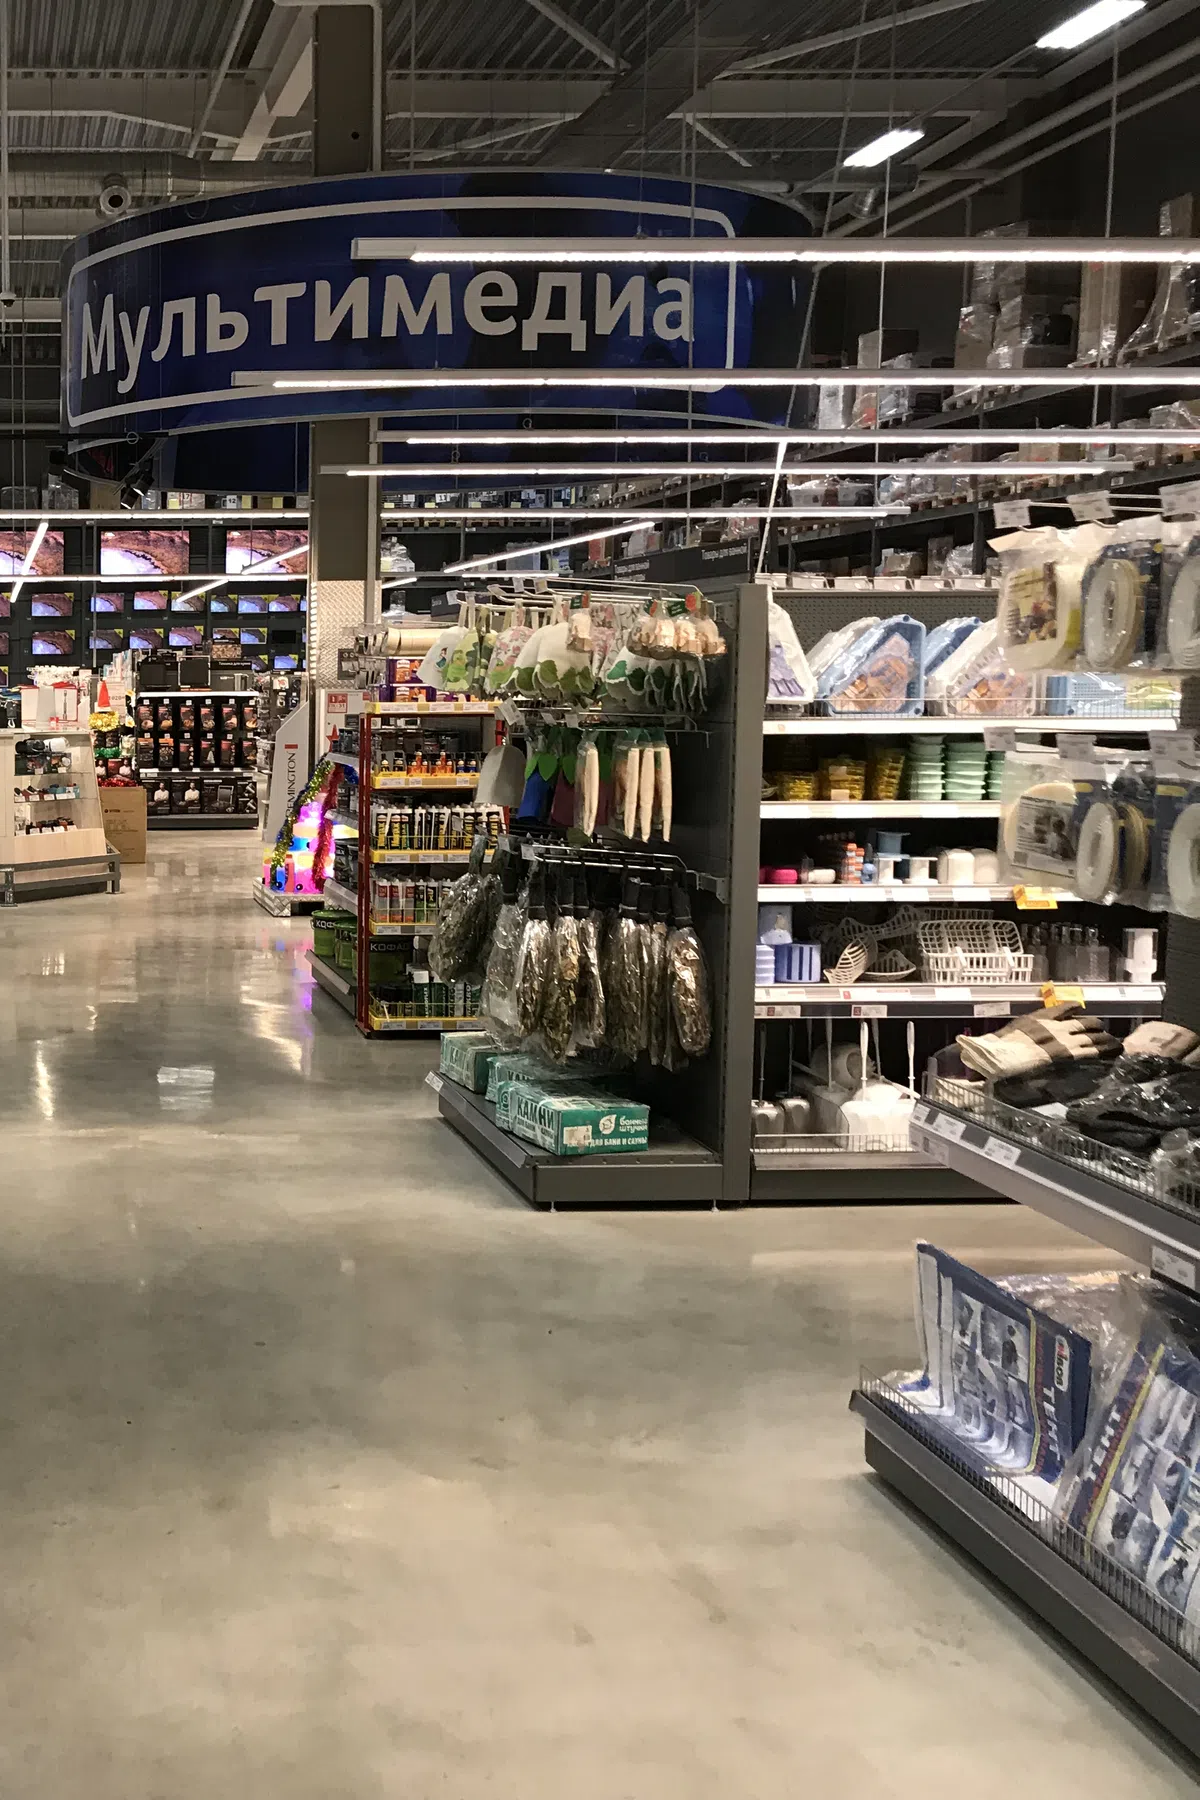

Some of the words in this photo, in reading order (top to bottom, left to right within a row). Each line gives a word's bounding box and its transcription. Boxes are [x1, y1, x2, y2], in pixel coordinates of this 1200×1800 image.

[80, 267, 694, 395] Мультимедиа
[285, 752, 296, 818] REMINGTON
[517, 1096, 554, 1131] КАМНИ
[604, 1138, 621, 1146] БАНИ
